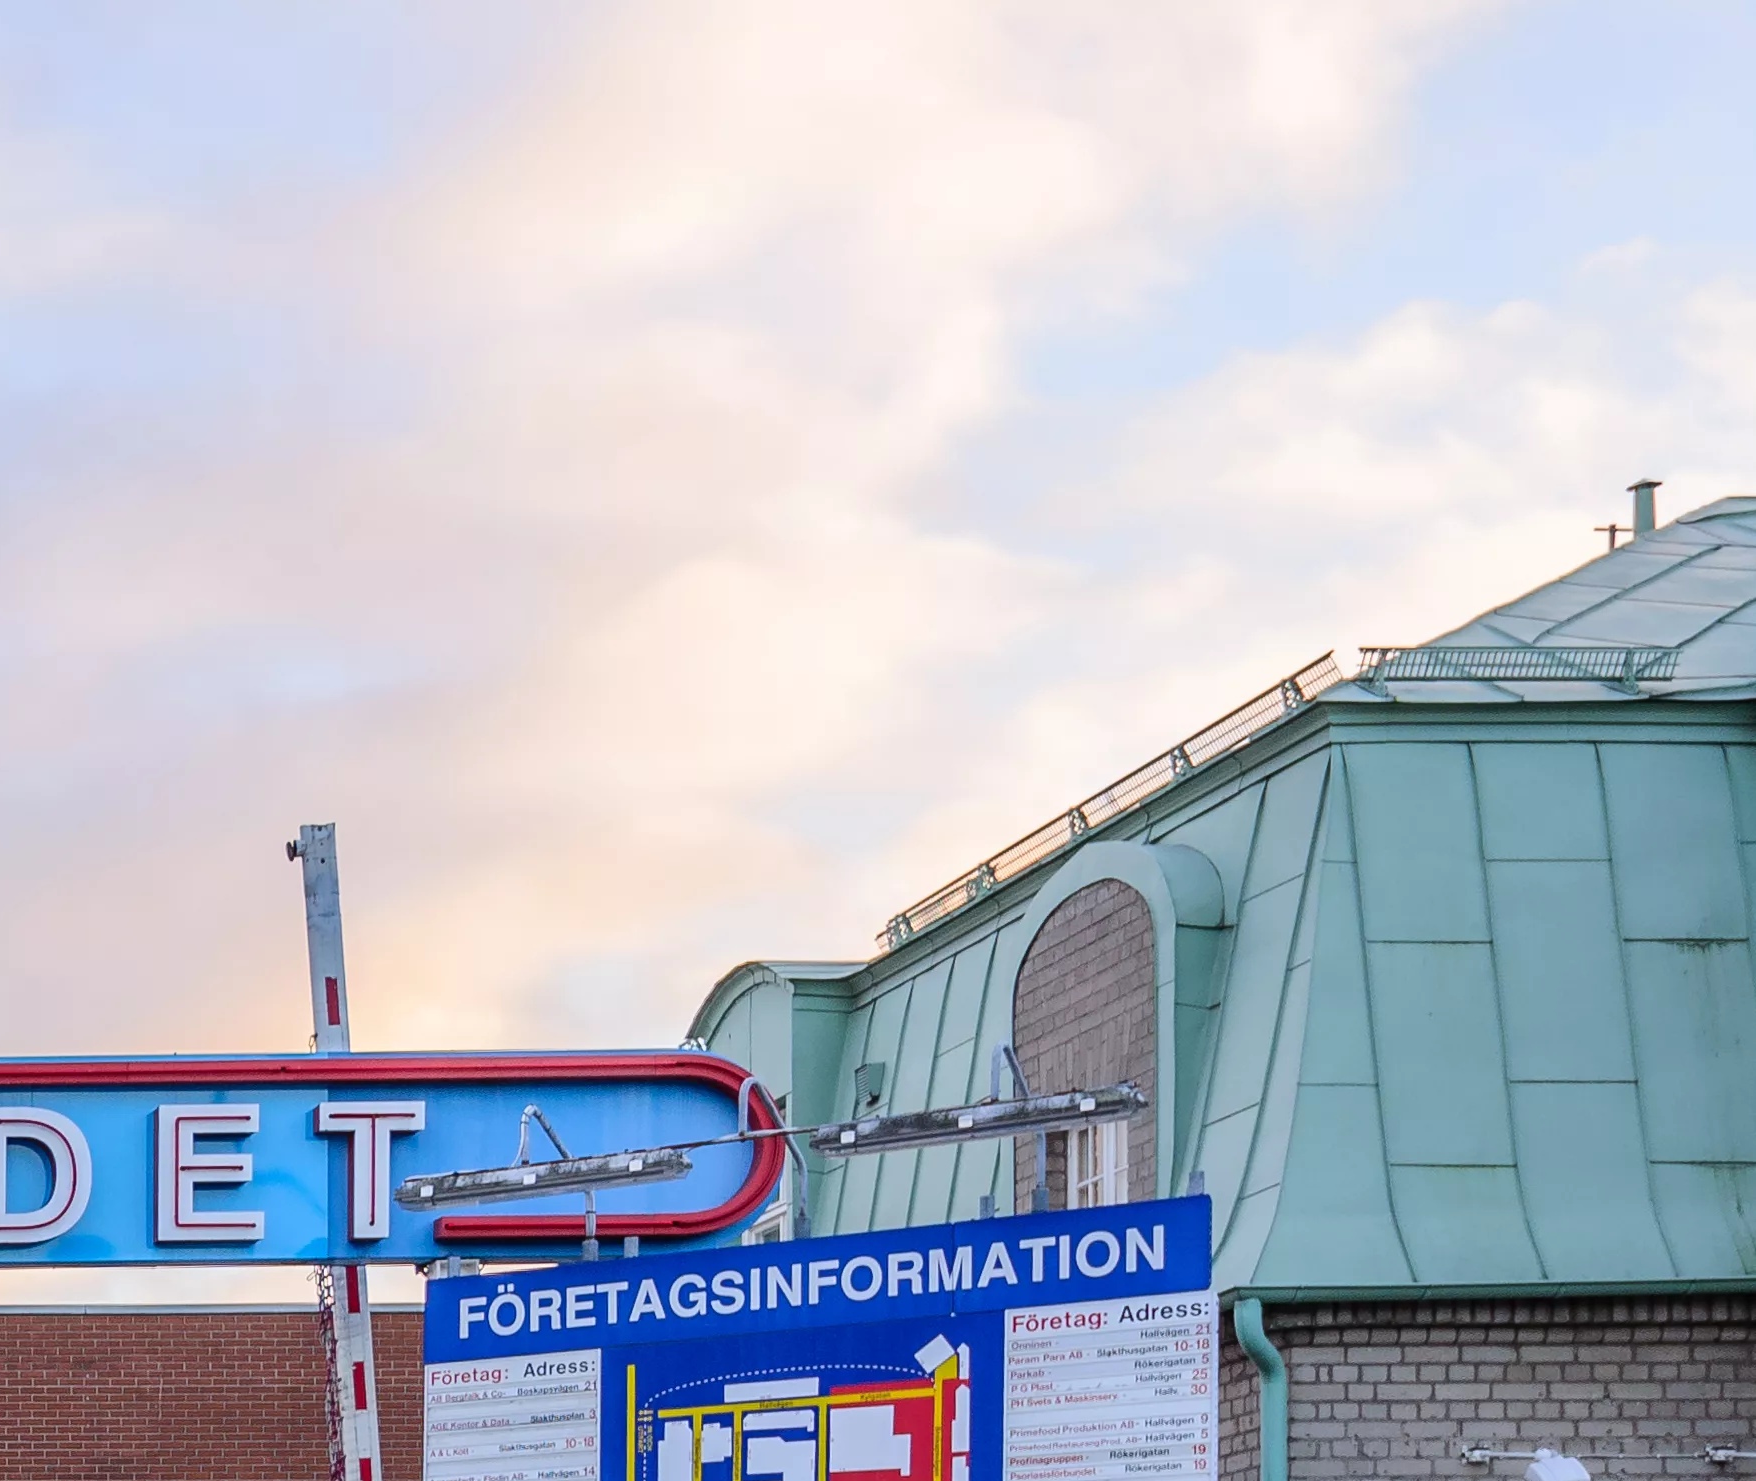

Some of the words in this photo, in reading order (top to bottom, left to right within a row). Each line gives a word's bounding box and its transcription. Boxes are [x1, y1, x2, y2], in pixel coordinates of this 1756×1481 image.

[459, 1224, 1164, 1339] FÖRETAGSINFORMATION
[1012, 1311, 1108, 1333] Företag:
[1118, 1301, 1210, 1324] Adress:
[431, 1367, 509, 1386] Företag:
[523, 1360, 596, 1378] Adress:
[1110, 1448, 1170, 1460] Rökerigatan
[1192, 1444, 1206, 1454] 19
[1194, 1458, 1206, 1470] 19
